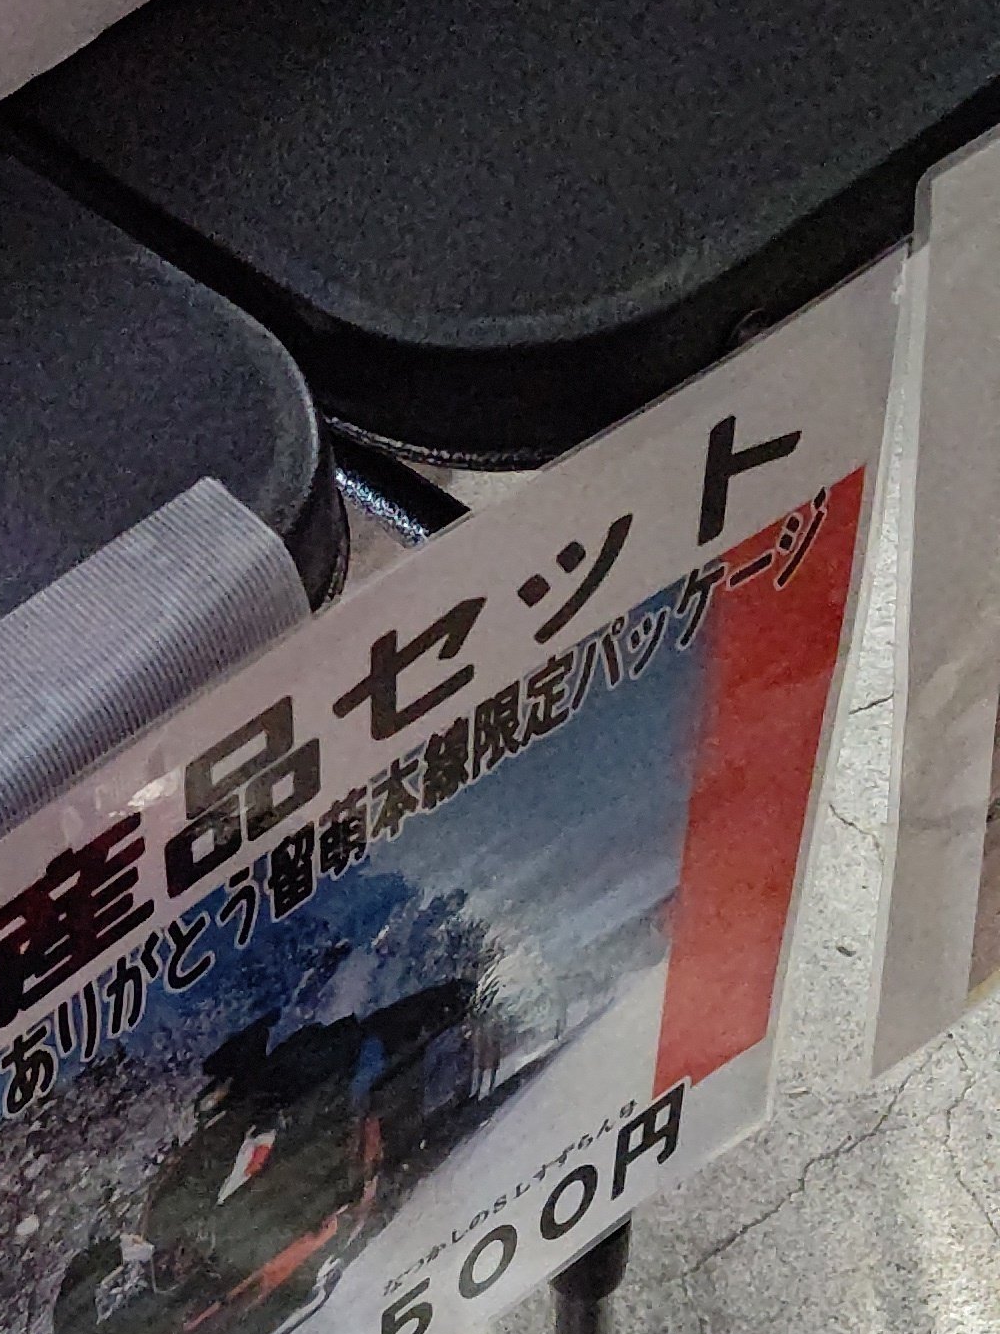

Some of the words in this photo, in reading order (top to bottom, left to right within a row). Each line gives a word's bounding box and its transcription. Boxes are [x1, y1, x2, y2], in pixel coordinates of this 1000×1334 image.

[2, 486, 829, 1117] ありがとう留萌本線限定パッケージ
